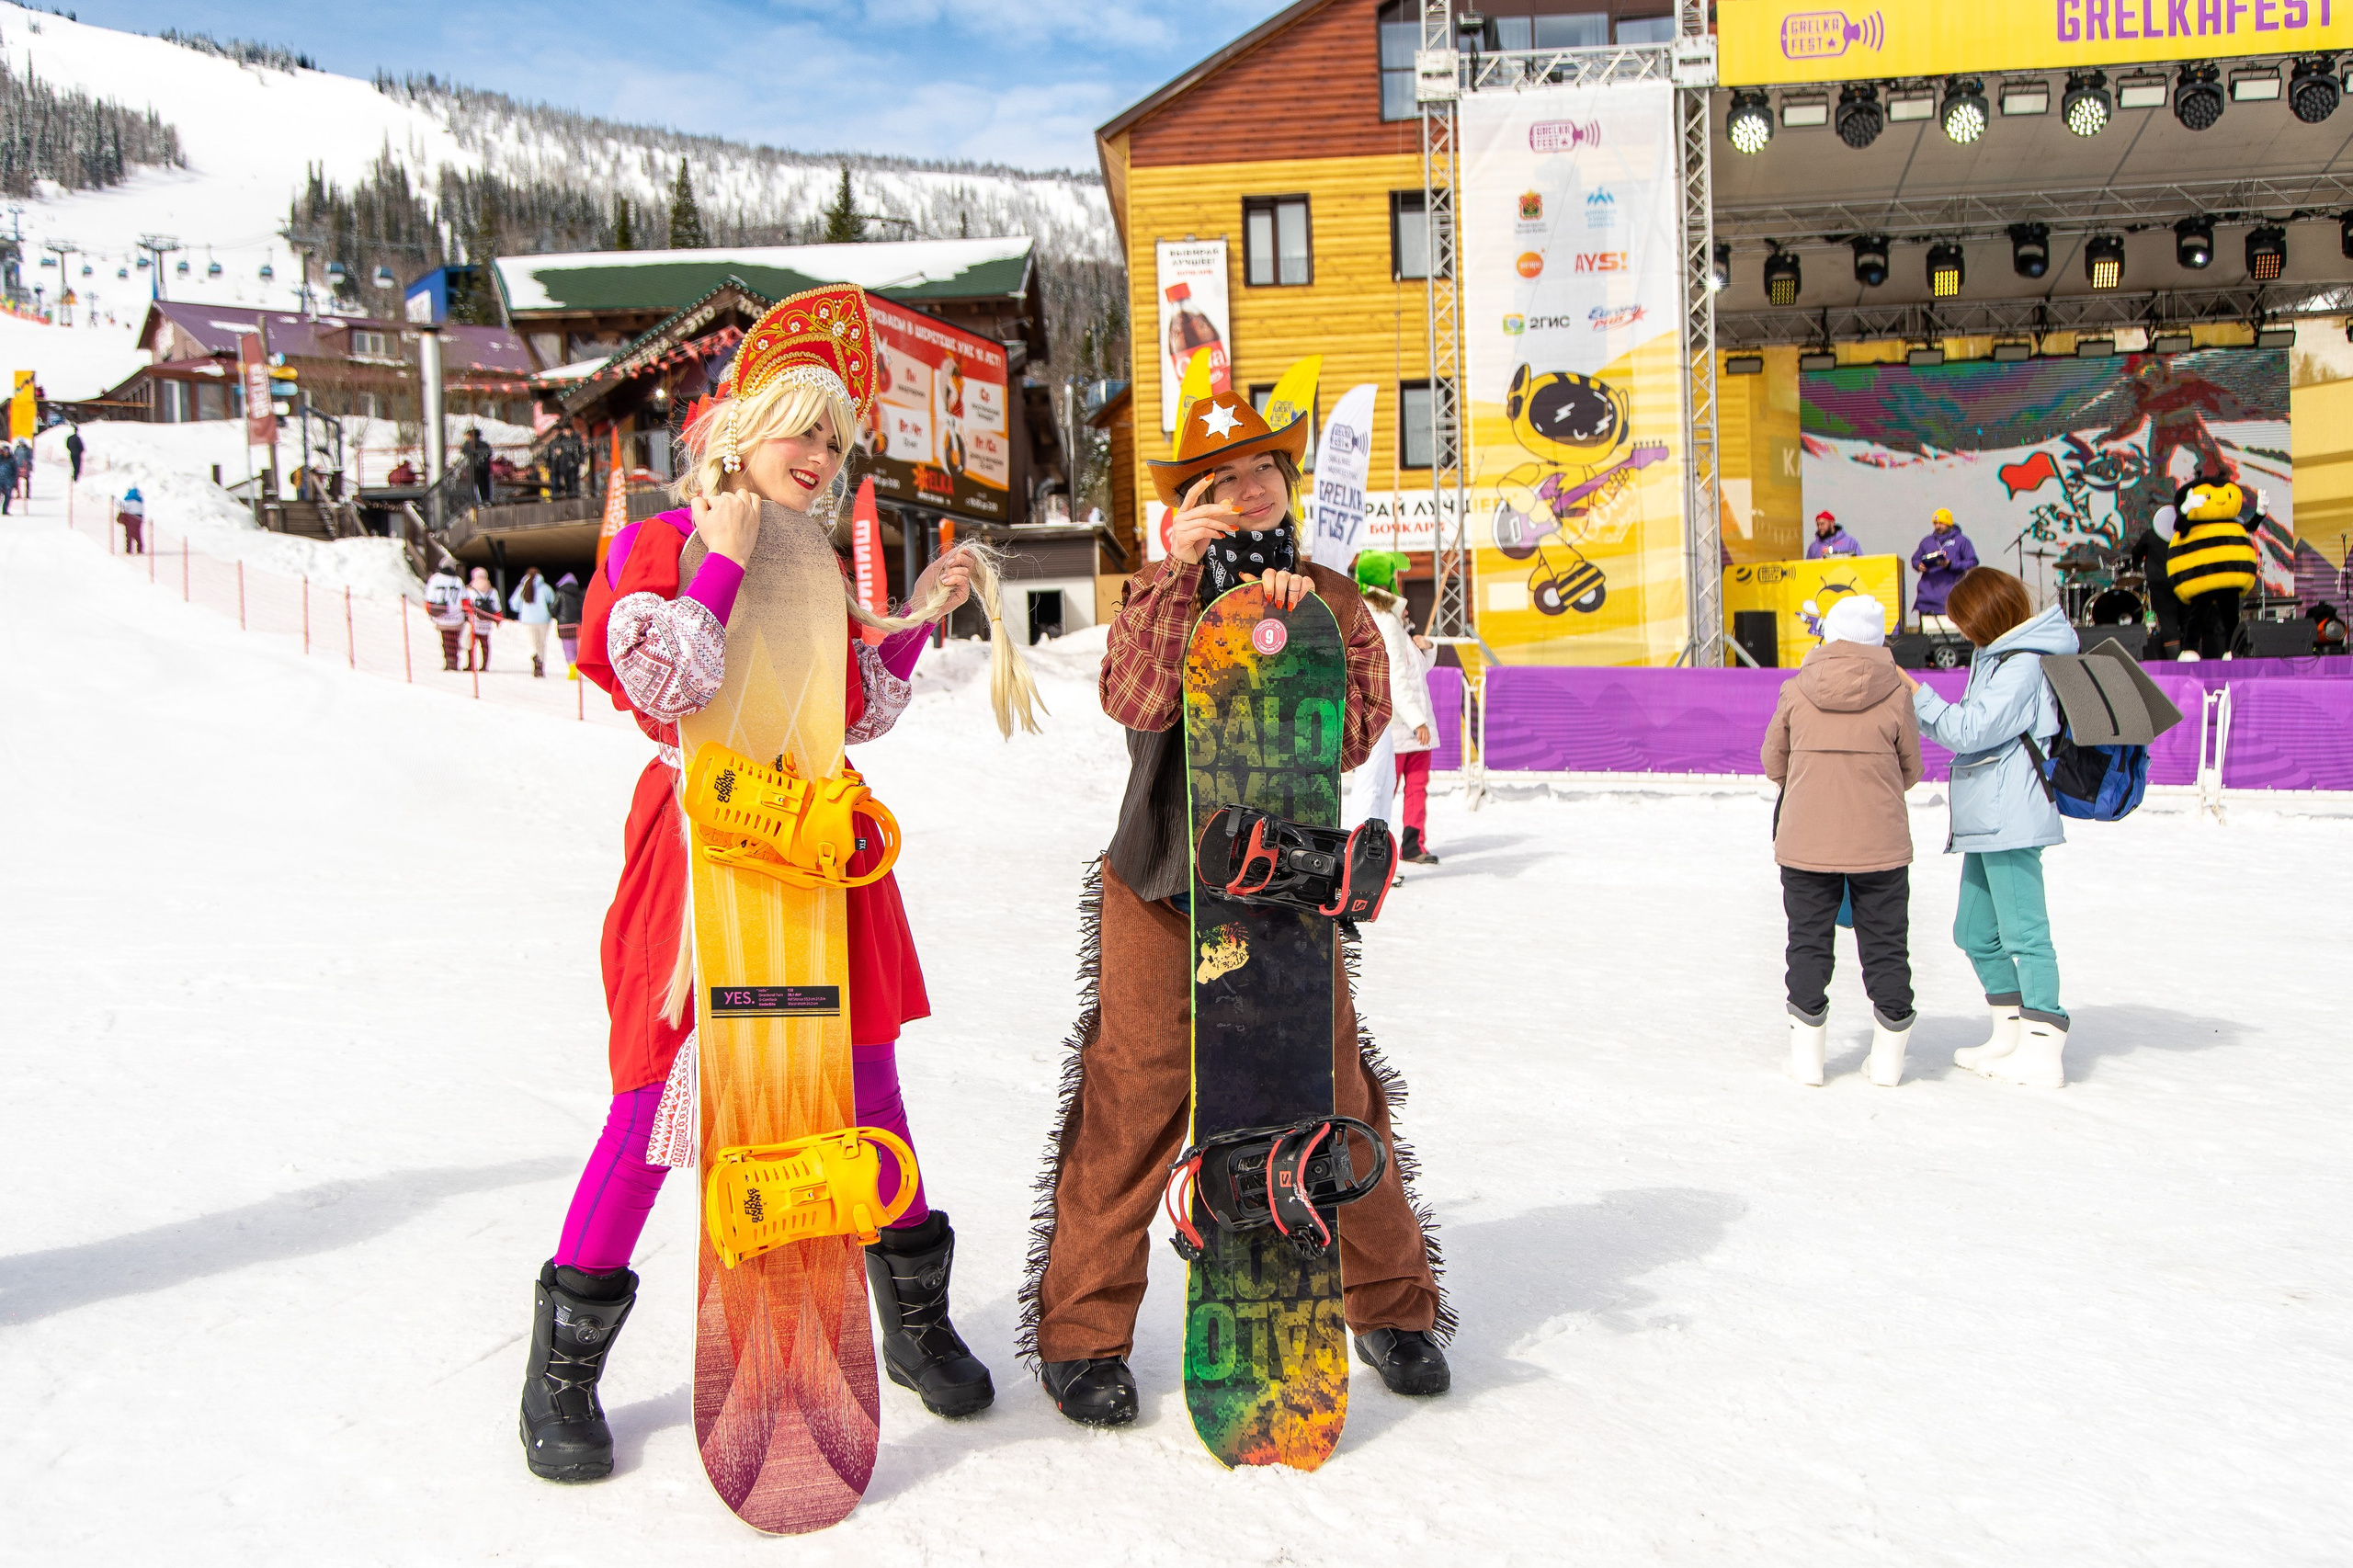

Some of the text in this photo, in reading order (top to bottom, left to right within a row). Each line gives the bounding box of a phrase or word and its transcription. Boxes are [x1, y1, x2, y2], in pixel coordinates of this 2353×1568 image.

[1791, 18, 1838, 34] GRELKA
[1791, 38, 1822, 52] FEST
[1530, 315, 1570, 330] 2ГИС
[1265, 629, 1274, 644] 9
[858, 839, 867, 850] FIX
[724, 991, 755, 1005] YES.
